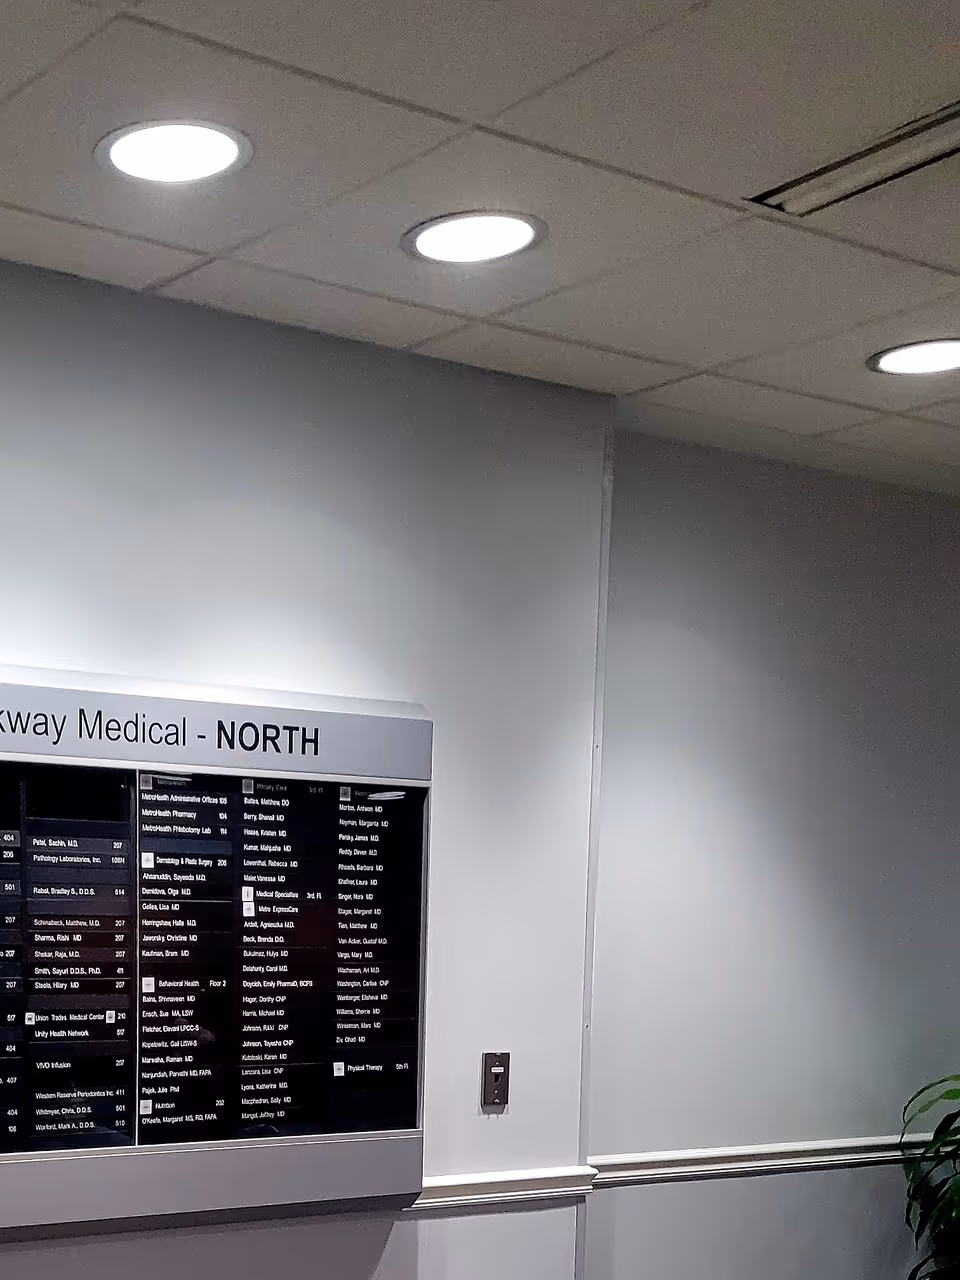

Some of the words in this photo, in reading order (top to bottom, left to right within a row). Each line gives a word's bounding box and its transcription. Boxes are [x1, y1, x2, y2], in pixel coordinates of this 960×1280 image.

[77, 709, 188, 747] Medical
[216, 720, 319, 756] NORTH
[33, 855, 58, 863] Pathology
